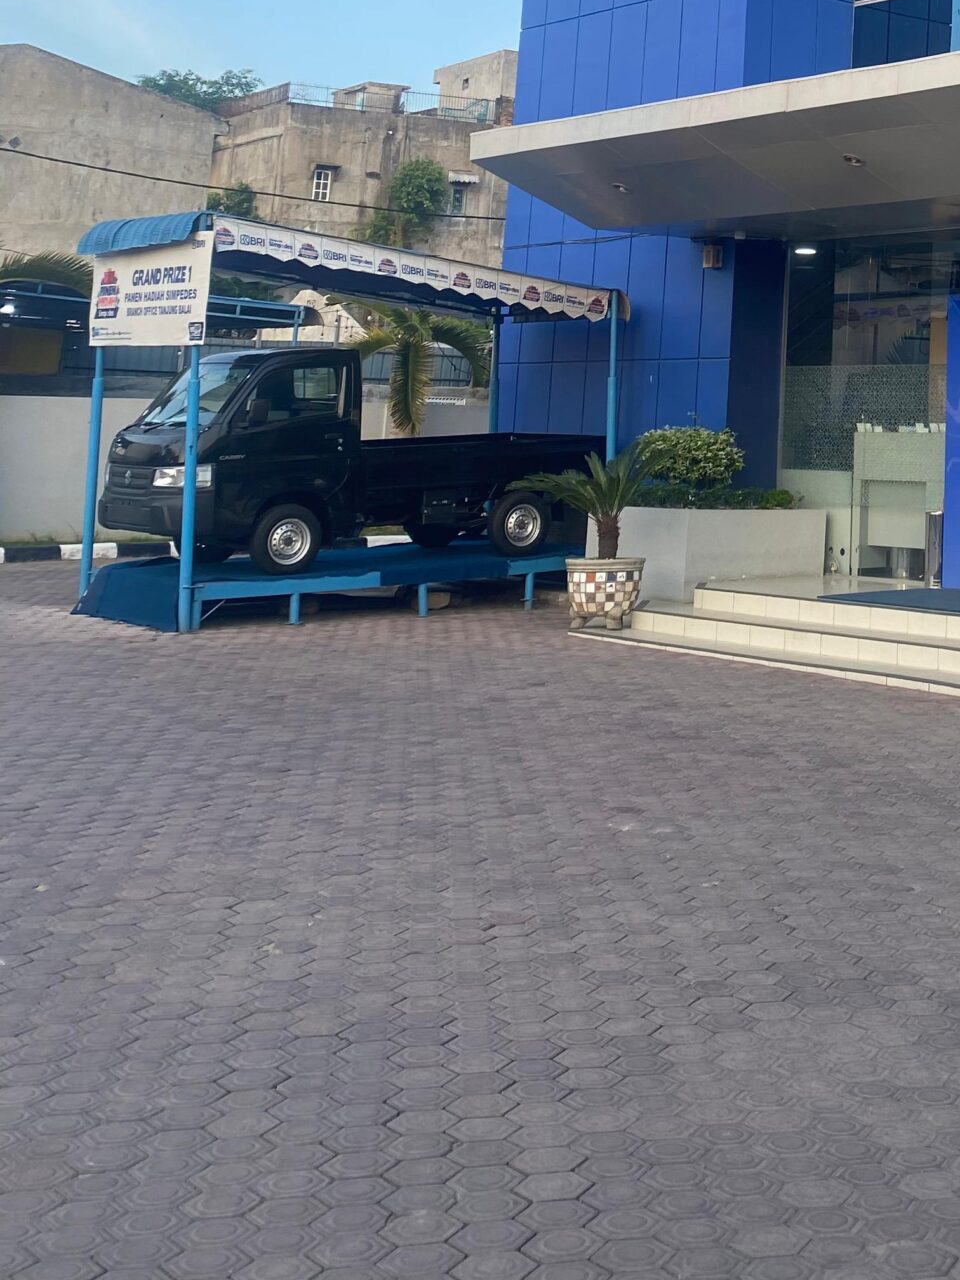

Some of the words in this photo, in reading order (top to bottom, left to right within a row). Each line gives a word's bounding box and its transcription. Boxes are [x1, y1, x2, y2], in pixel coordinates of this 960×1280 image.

[250, 236, 266, 247] BRI
[269, 240, 293, 250] Simpdes
[332, 251, 347, 262] BRI
[132, 268, 161, 287] GRAND
[163, 266, 187, 284] PRIZE
[188, 265, 192, 283] 1
[410, 266, 424, 276] BRI
[484, 280, 497, 291] BRI
[125, 292, 142, 303] PANEN
[143, 290, 165, 302] HADIAH
[166, 289, 197, 301] SIMPEDES
[552, 294, 565, 304] BRI
[143, 306, 158, 316] OFFICE
